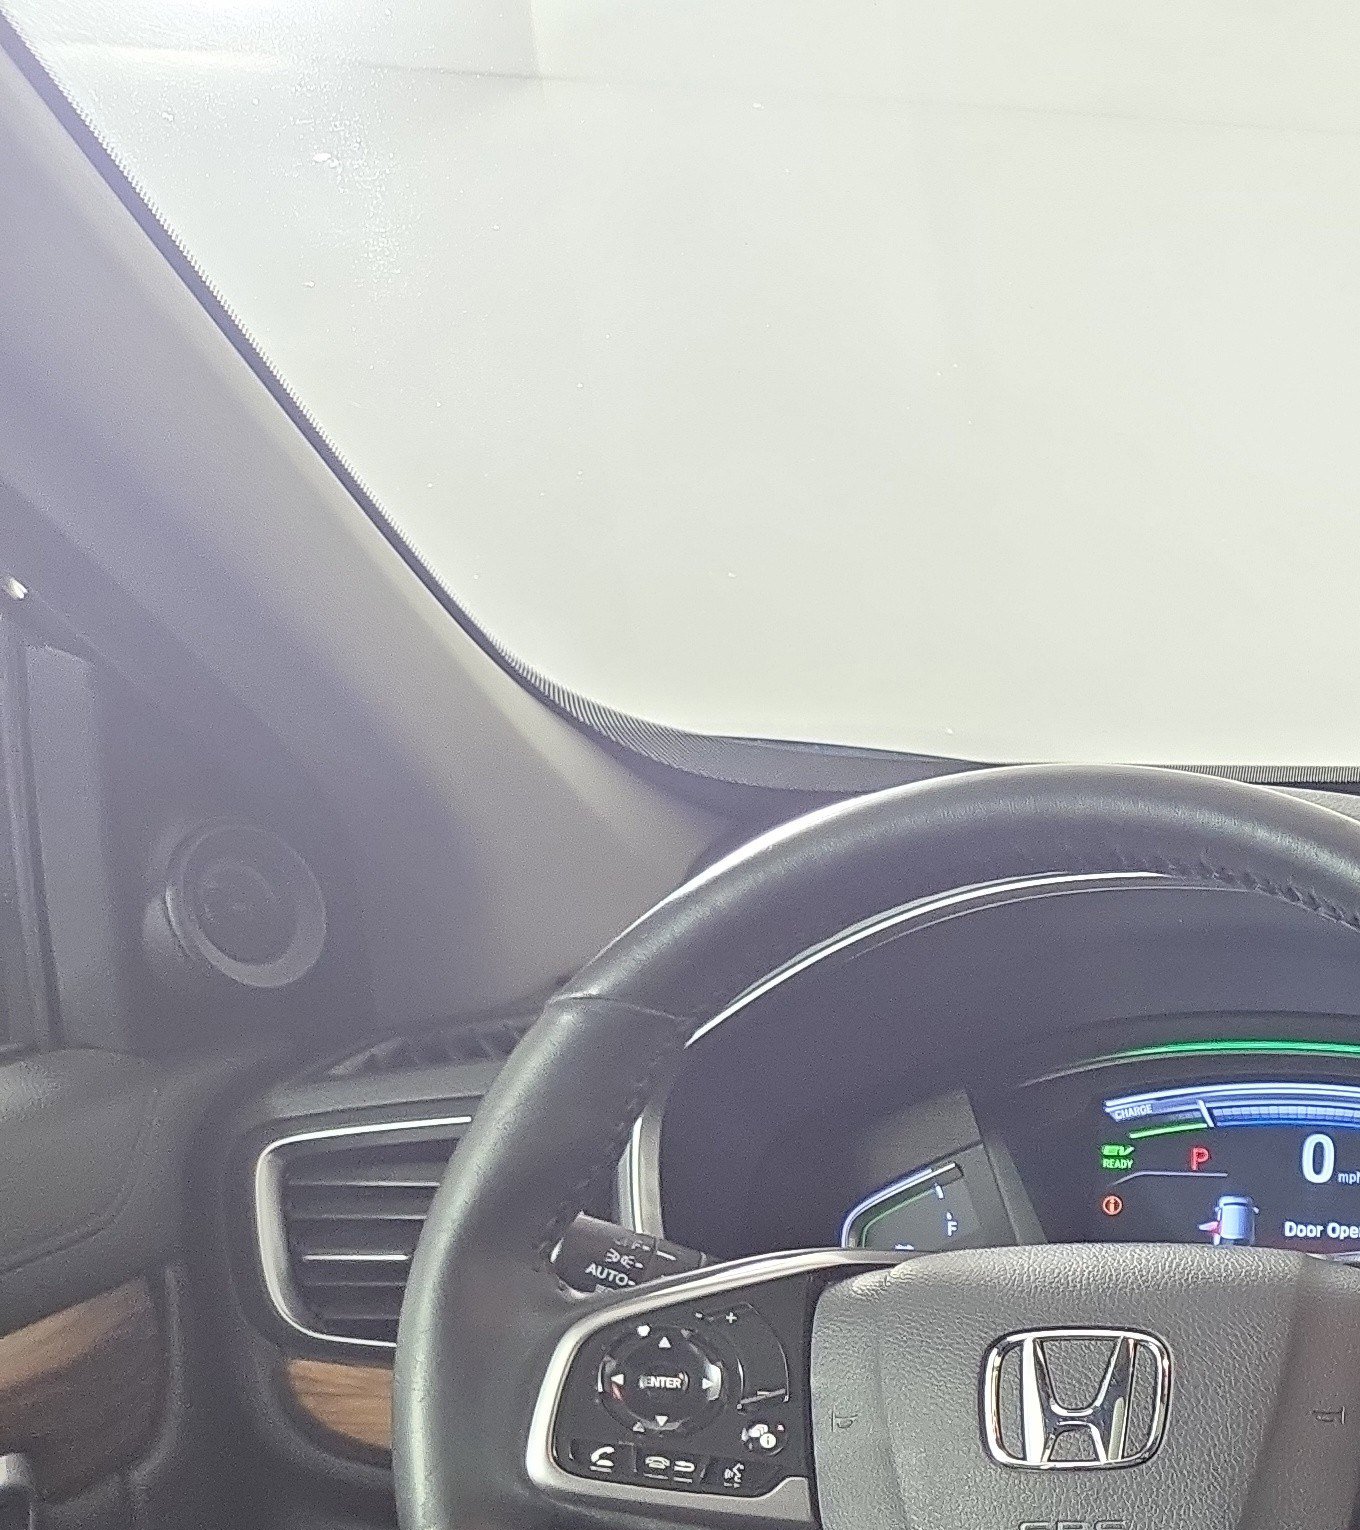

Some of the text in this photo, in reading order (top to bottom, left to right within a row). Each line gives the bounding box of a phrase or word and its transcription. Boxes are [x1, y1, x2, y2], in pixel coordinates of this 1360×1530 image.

[1113, 1103, 1153, 1119] CHARGE
[1102, 1158, 1134, 1169] READY
[1190, 1146, 1210, 1170] P
[1302, 1133, 1335, 1184] 0
[1284, 1220, 1324, 1238] Door
[585, 1262, 629, 1286] AUTO
[642, 1375, 683, 1389] ENTER
